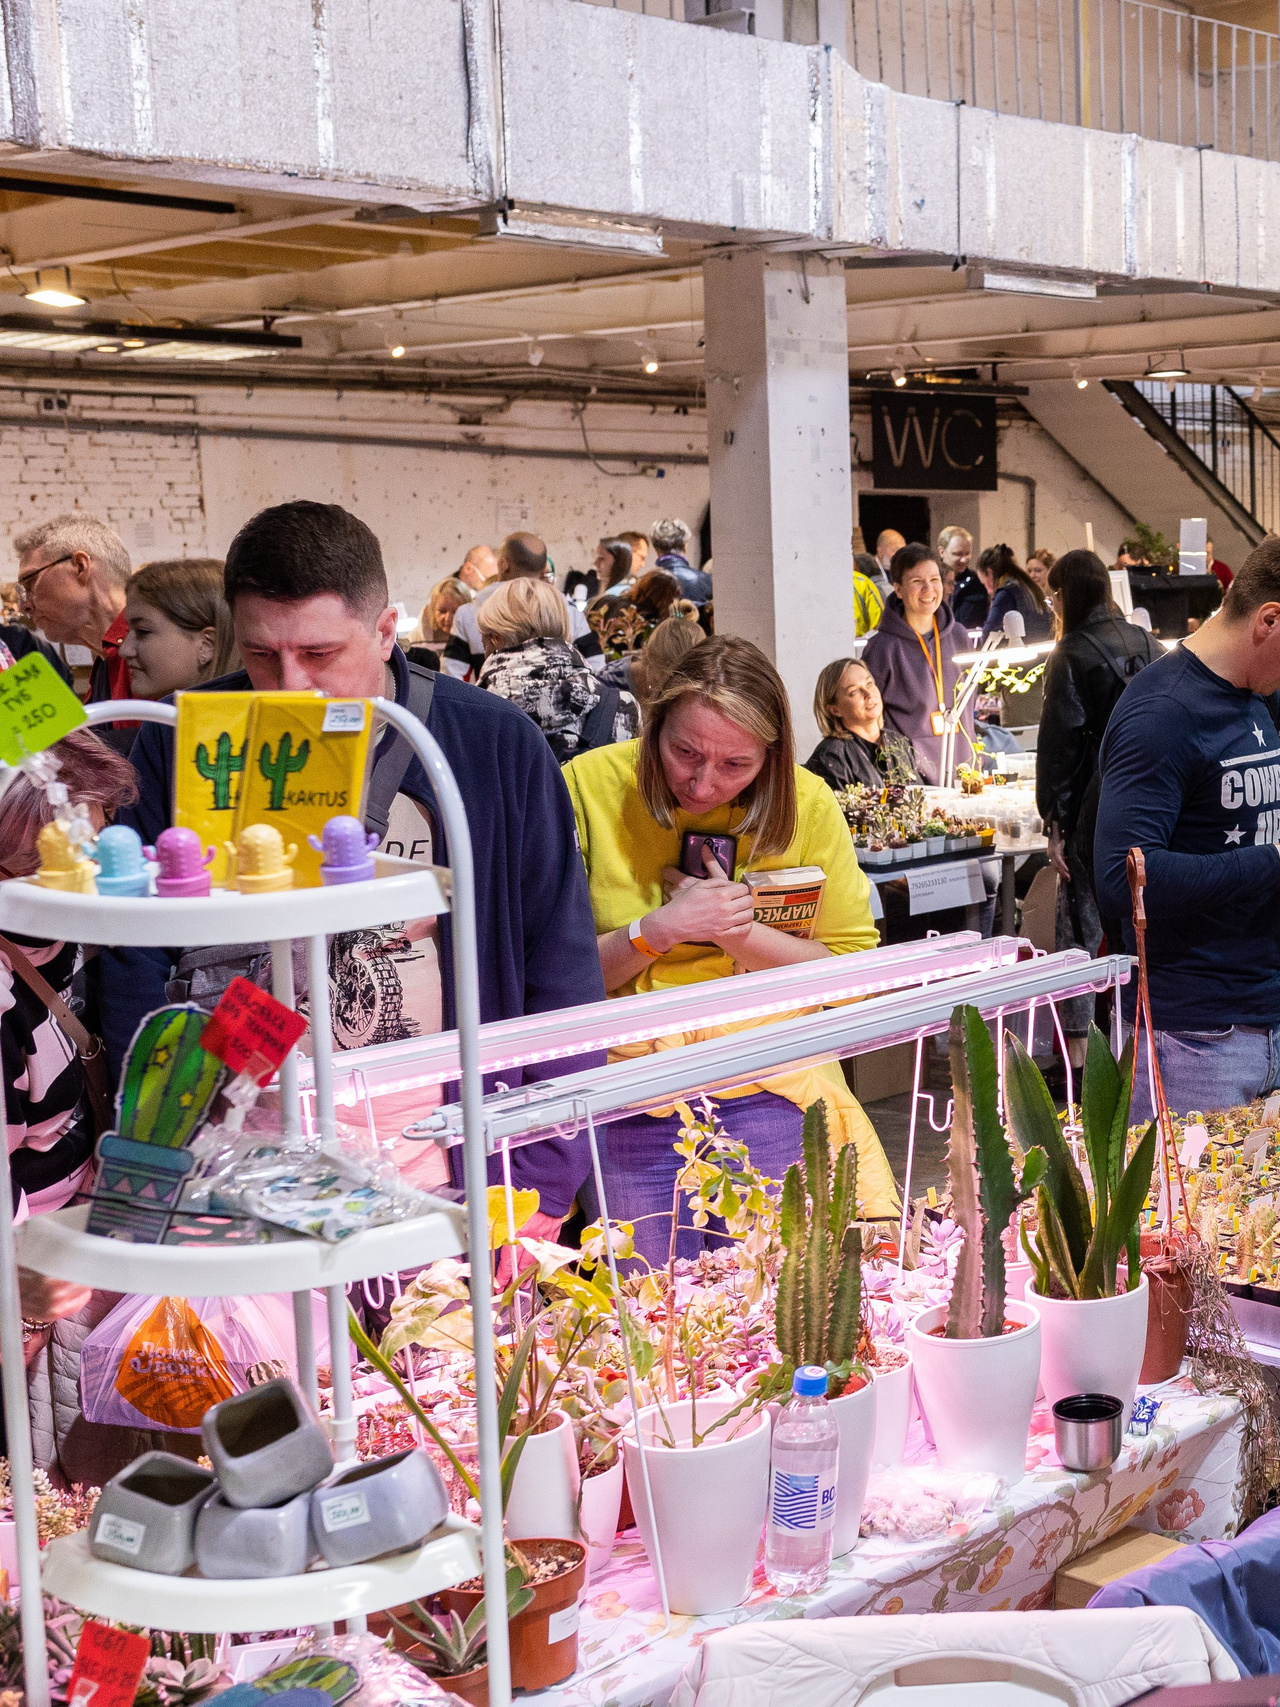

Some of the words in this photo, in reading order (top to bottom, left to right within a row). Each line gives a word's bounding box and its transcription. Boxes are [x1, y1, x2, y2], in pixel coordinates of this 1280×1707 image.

[882, 405, 984, 469] WC
[22, 703, 57, 729] 250
[286, 790, 348, 808] KAKTUS
[755, 903, 816, 922] МАРКЕС
